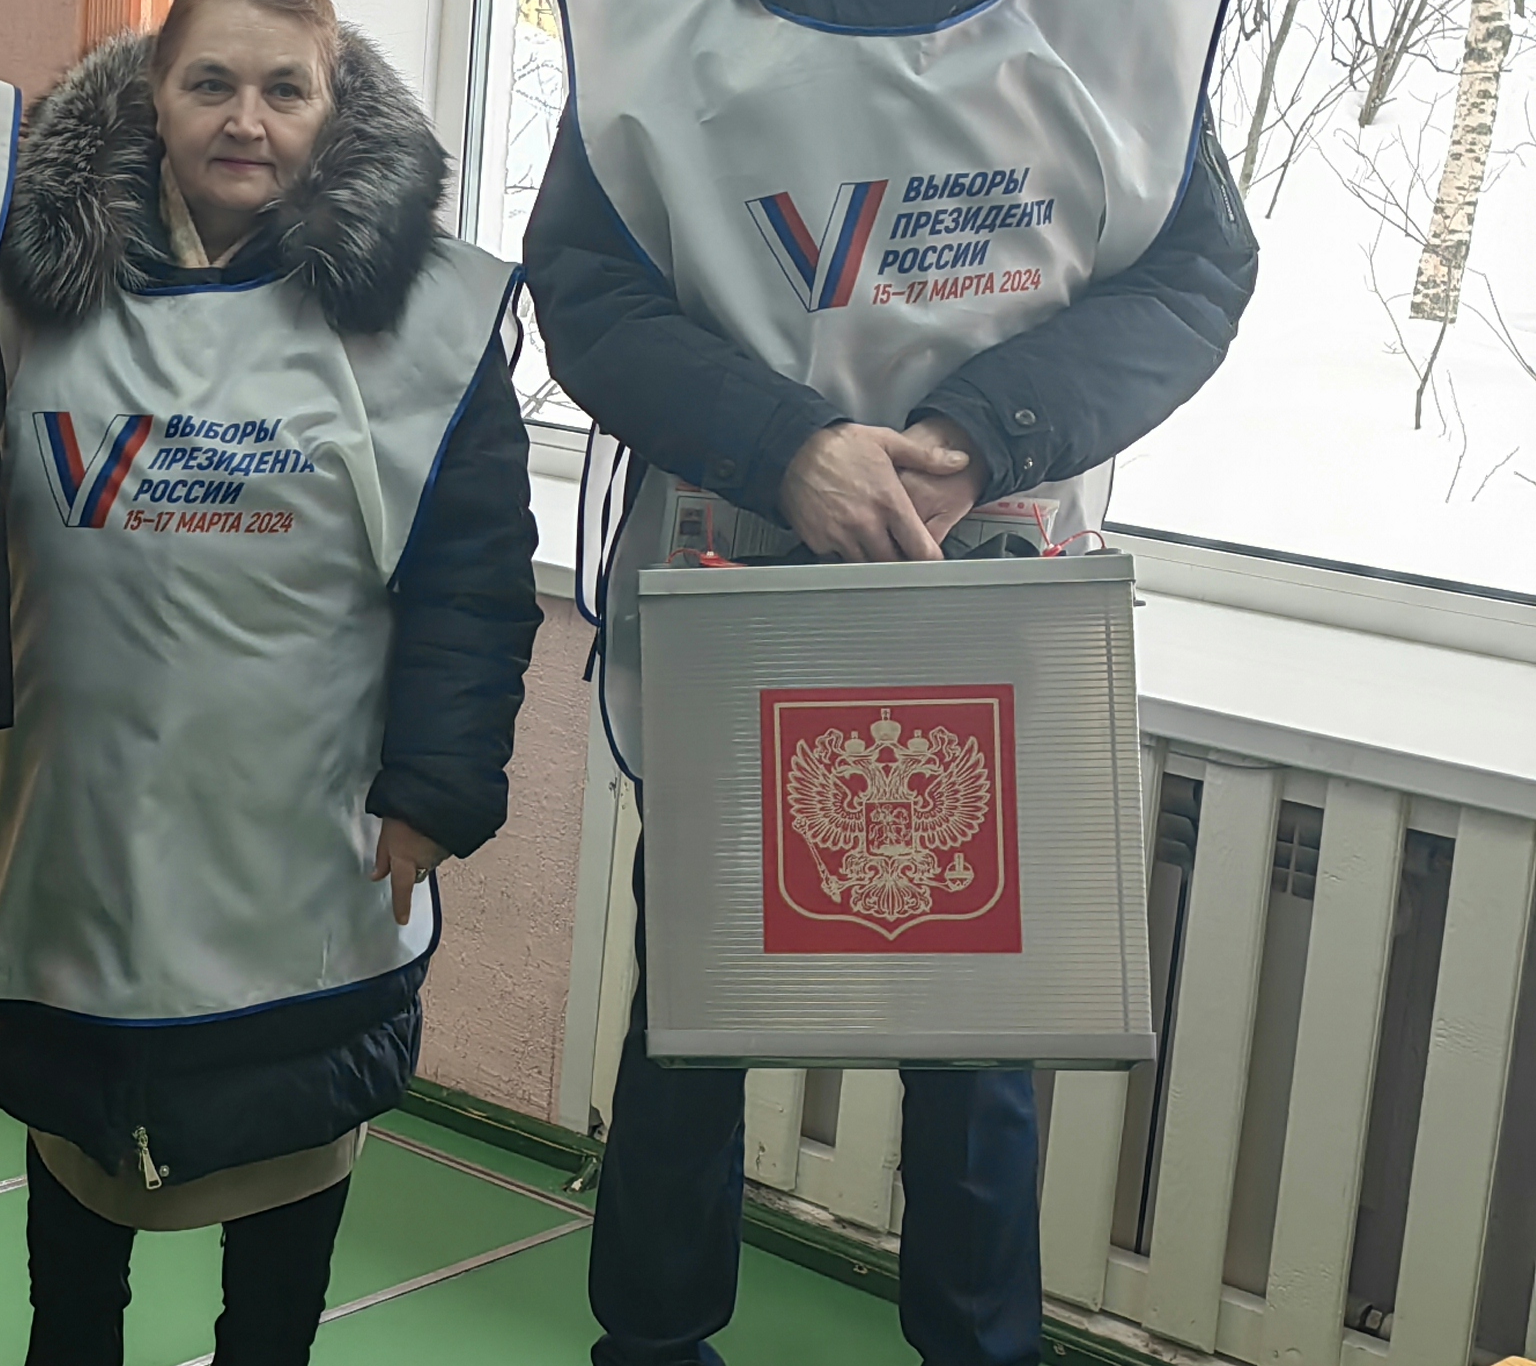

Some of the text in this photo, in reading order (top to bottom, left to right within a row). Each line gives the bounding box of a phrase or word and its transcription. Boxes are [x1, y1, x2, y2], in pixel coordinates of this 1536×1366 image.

[902, 167, 1030, 203] ВЫБОРЫ
[889, 198, 1055, 240] ПРЕЗИДЕНТА
[877, 239, 991, 276] РОССИИ
[928, 272, 995, 303] МАРТА
[998, 268, 1042, 294] 2024
[164, 414, 283, 445] ВЫБОРЫ
[147, 447, 315, 476] ПРЕЗИДЕНТА
[132, 479, 245, 505] РОССИИ
[175, 510, 242, 534] МАРТА
[244, 511, 294, 534] 2024
